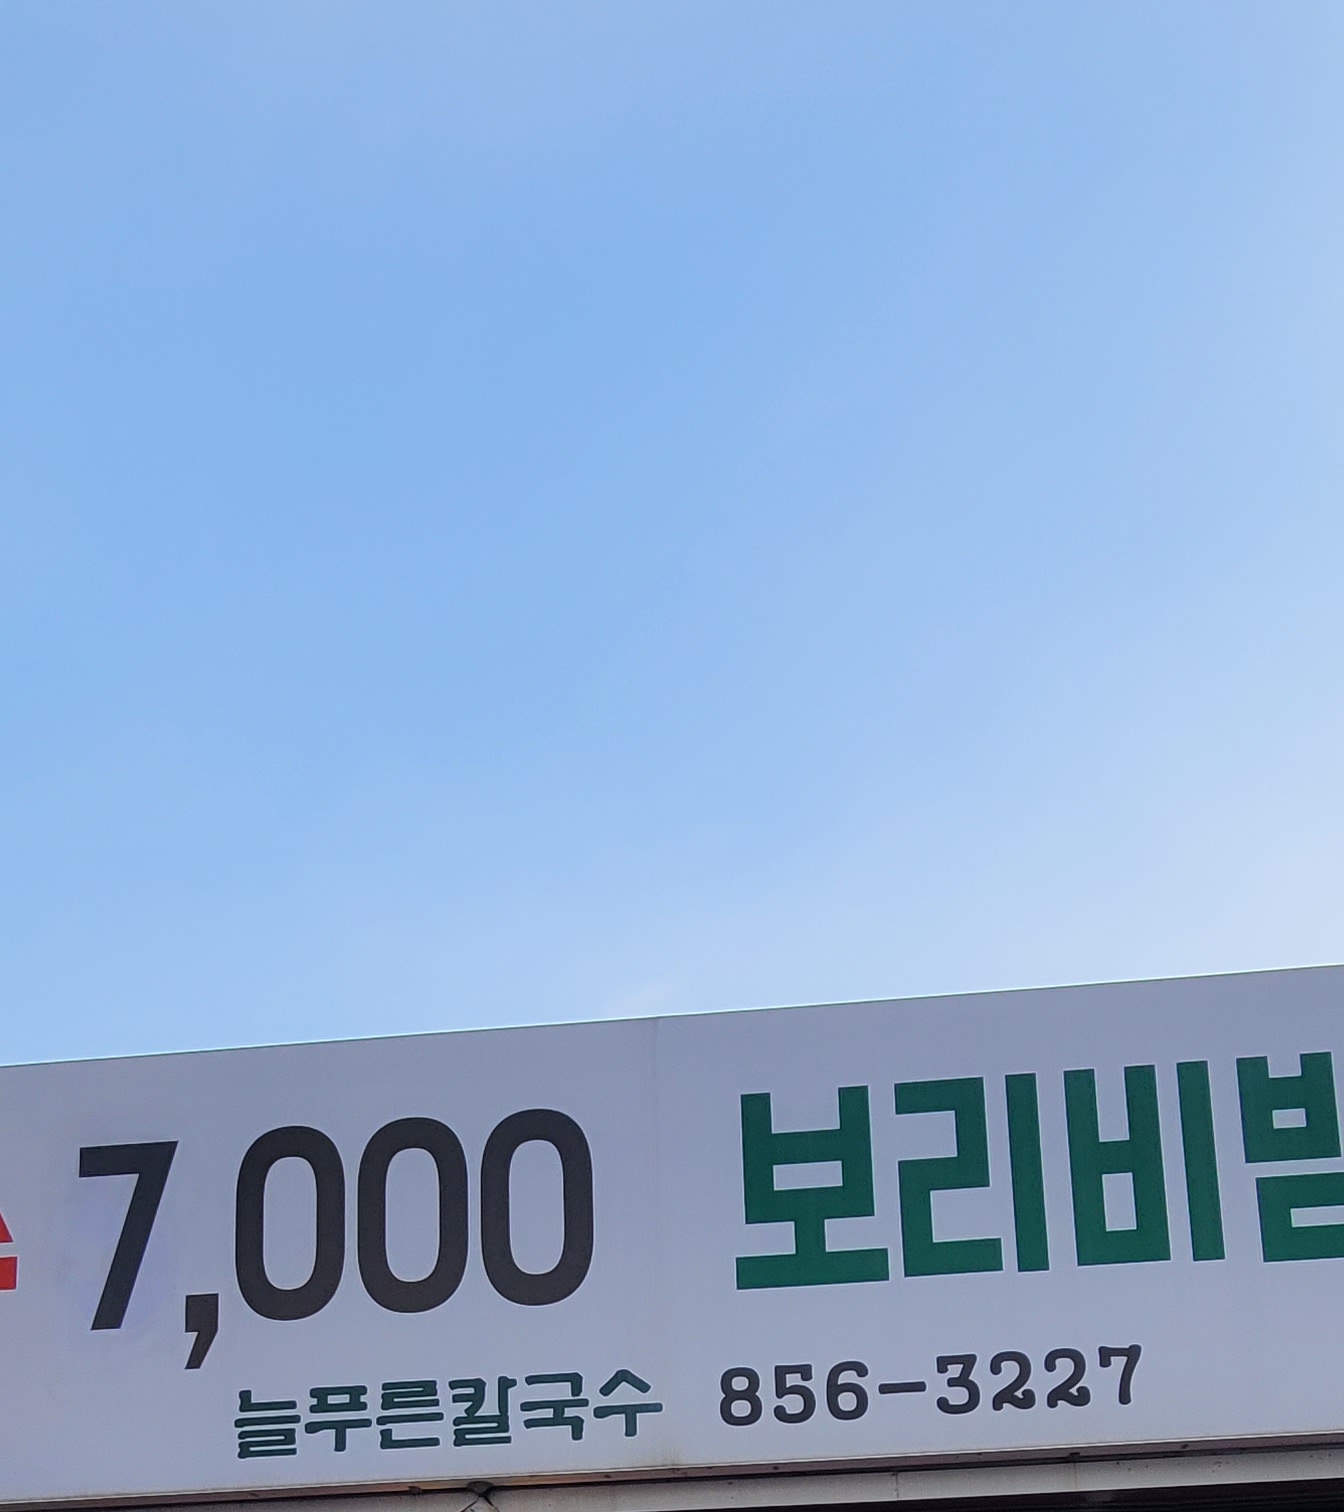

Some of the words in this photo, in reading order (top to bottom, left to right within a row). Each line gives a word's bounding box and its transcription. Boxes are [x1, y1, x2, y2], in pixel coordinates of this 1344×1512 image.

[77, 1107, 595, 1371] 7,000
[234, 1367, 664, 1459] 늘푸른칼국수
[717, 1342, 1144, 1427] 856-3227
